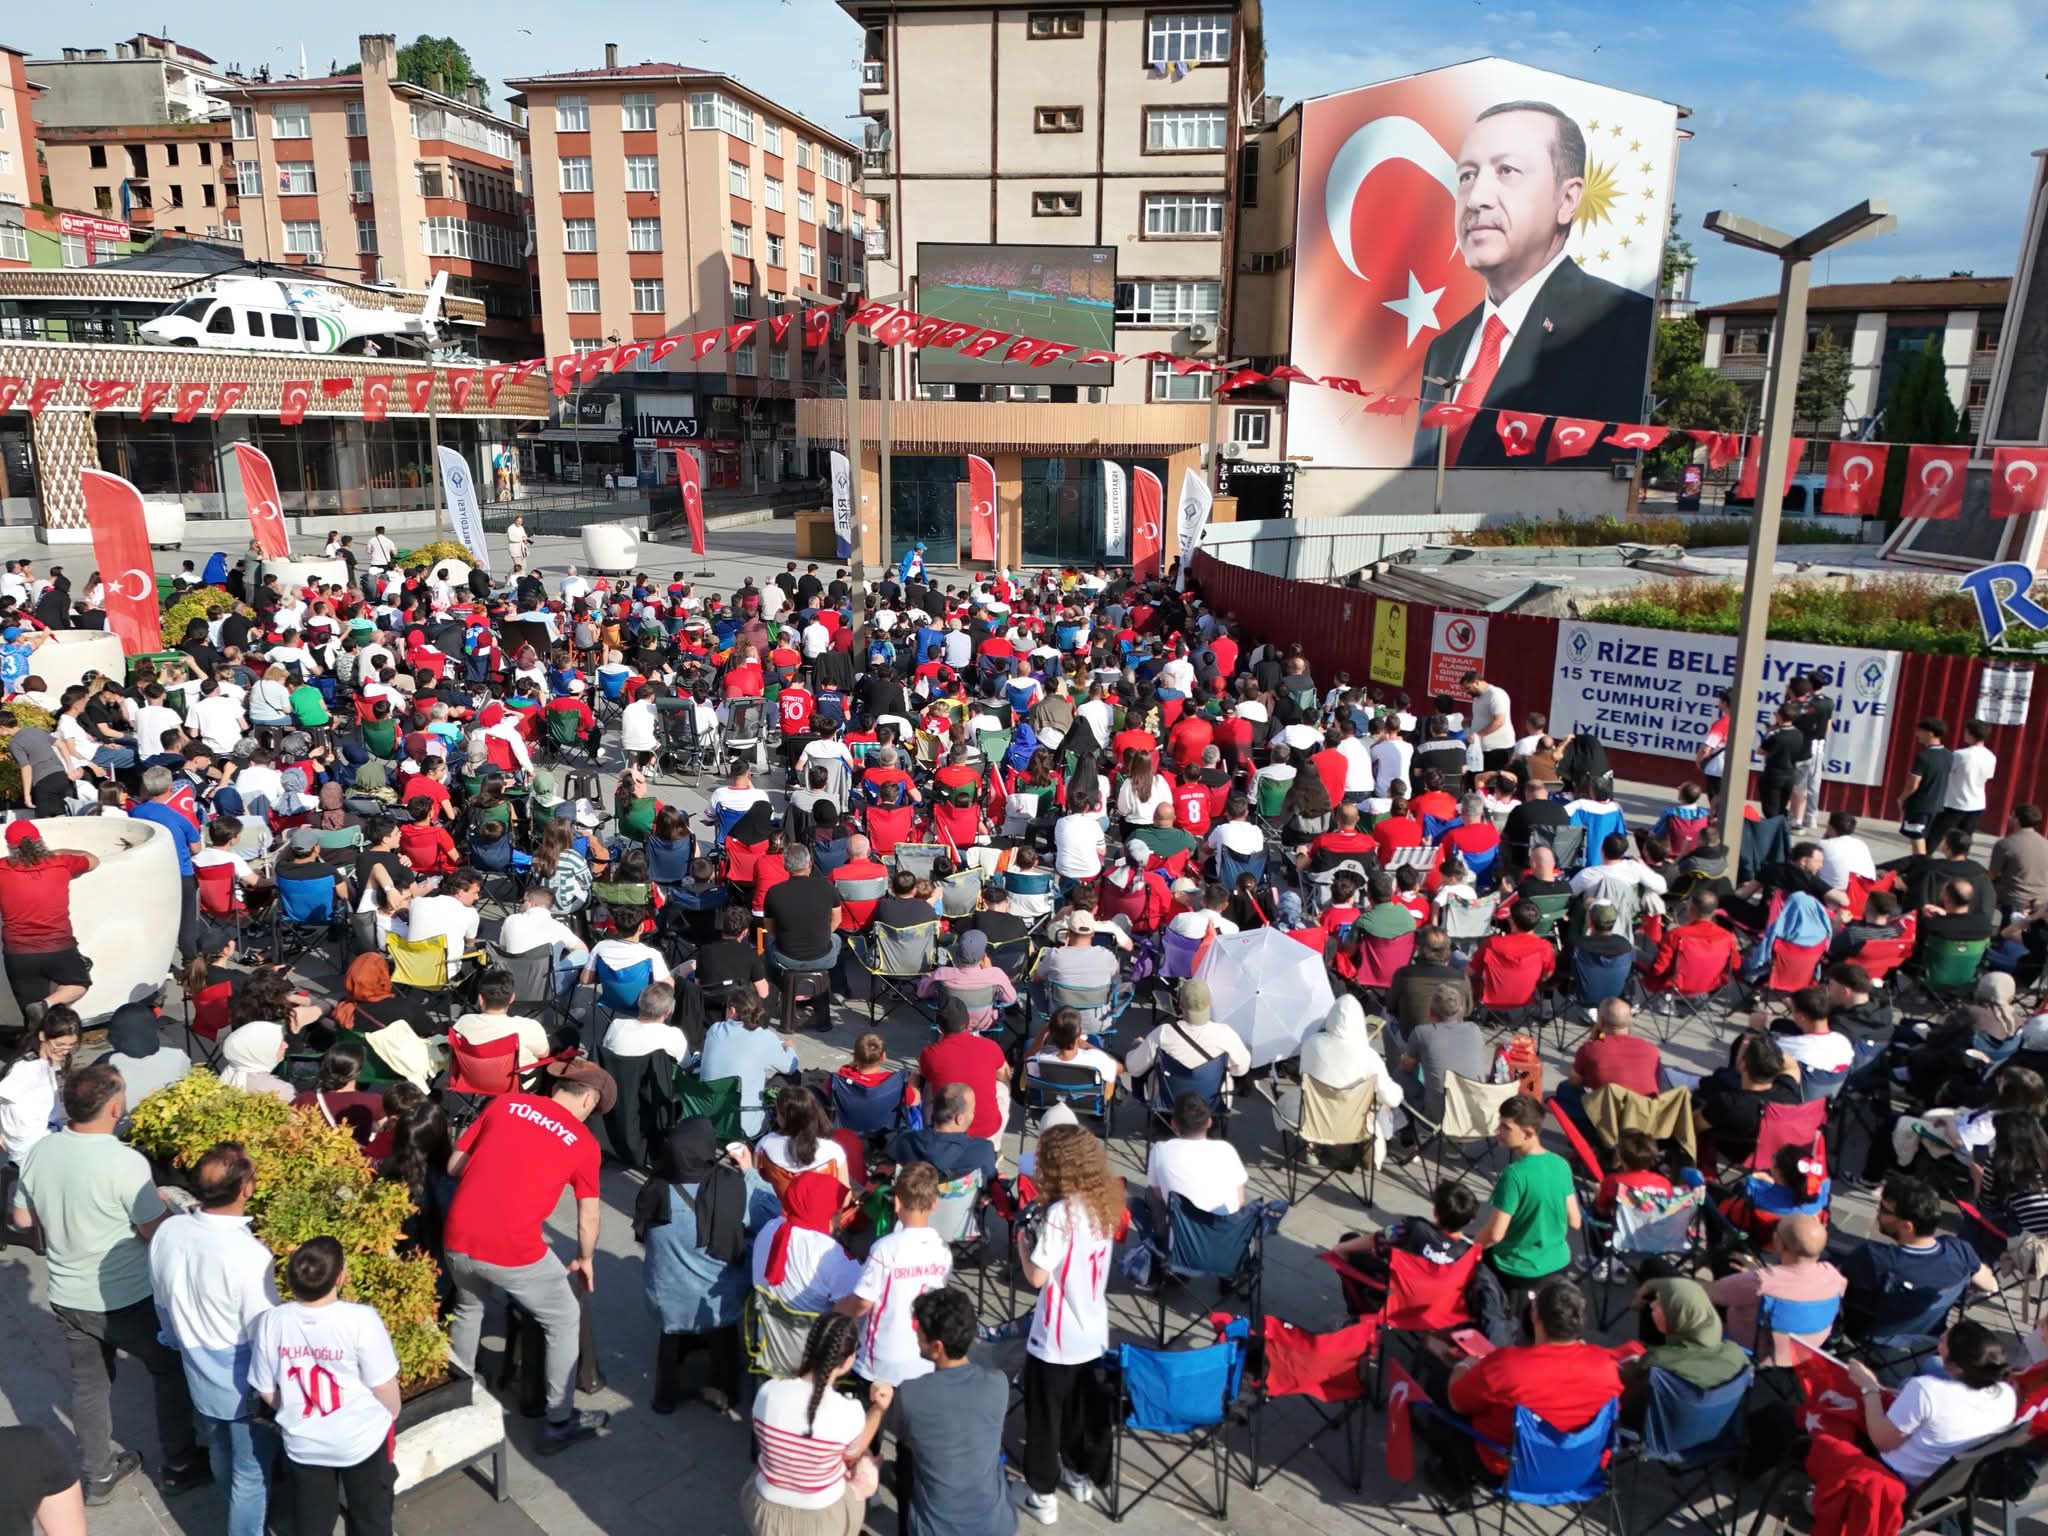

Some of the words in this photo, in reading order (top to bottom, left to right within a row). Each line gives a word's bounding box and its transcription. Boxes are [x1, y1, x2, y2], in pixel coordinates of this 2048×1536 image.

[651, 417, 698, 437] İMAJ
[1232, 463, 1281, 474] KUAFÖR
[1597, 638, 1659, 668] RİZE
[1667, 648, 1847, 689] BELEİYESİ
[1560, 665, 1583, 681] 15
[1589, 669, 1683, 694] TEMMUZ
[1852, 700, 1887, 717] VE
[782, 701, 803, 720] 10
[1595, 707, 1664, 730] ZEMİN
[1188, 799, 1201, 824] 8
[287, 1363, 342, 1417] 10
